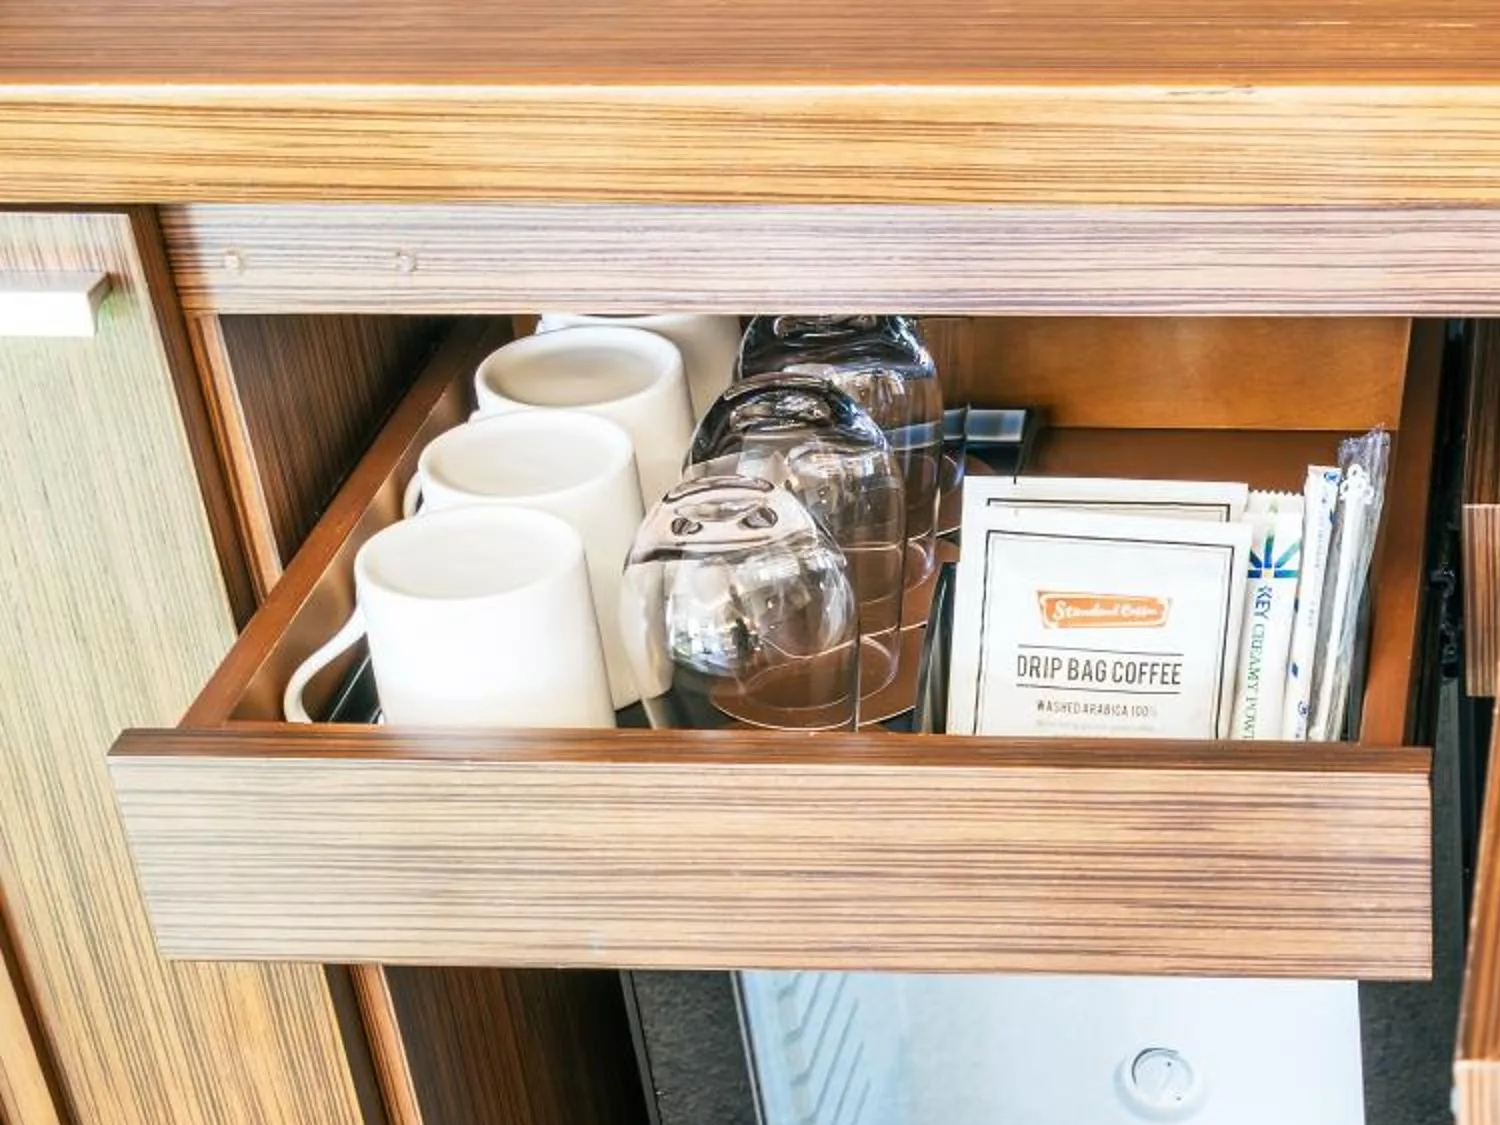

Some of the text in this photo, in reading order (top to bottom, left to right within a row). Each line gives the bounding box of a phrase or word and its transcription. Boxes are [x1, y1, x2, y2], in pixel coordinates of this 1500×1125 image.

[1253, 586, 1272, 619] KEY
[1017, 654, 1183, 685] DRIP BAG COFFEE
[1037, 700, 1081, 715] WASHED
[1083, 703, 1129, 718] ARABICA
